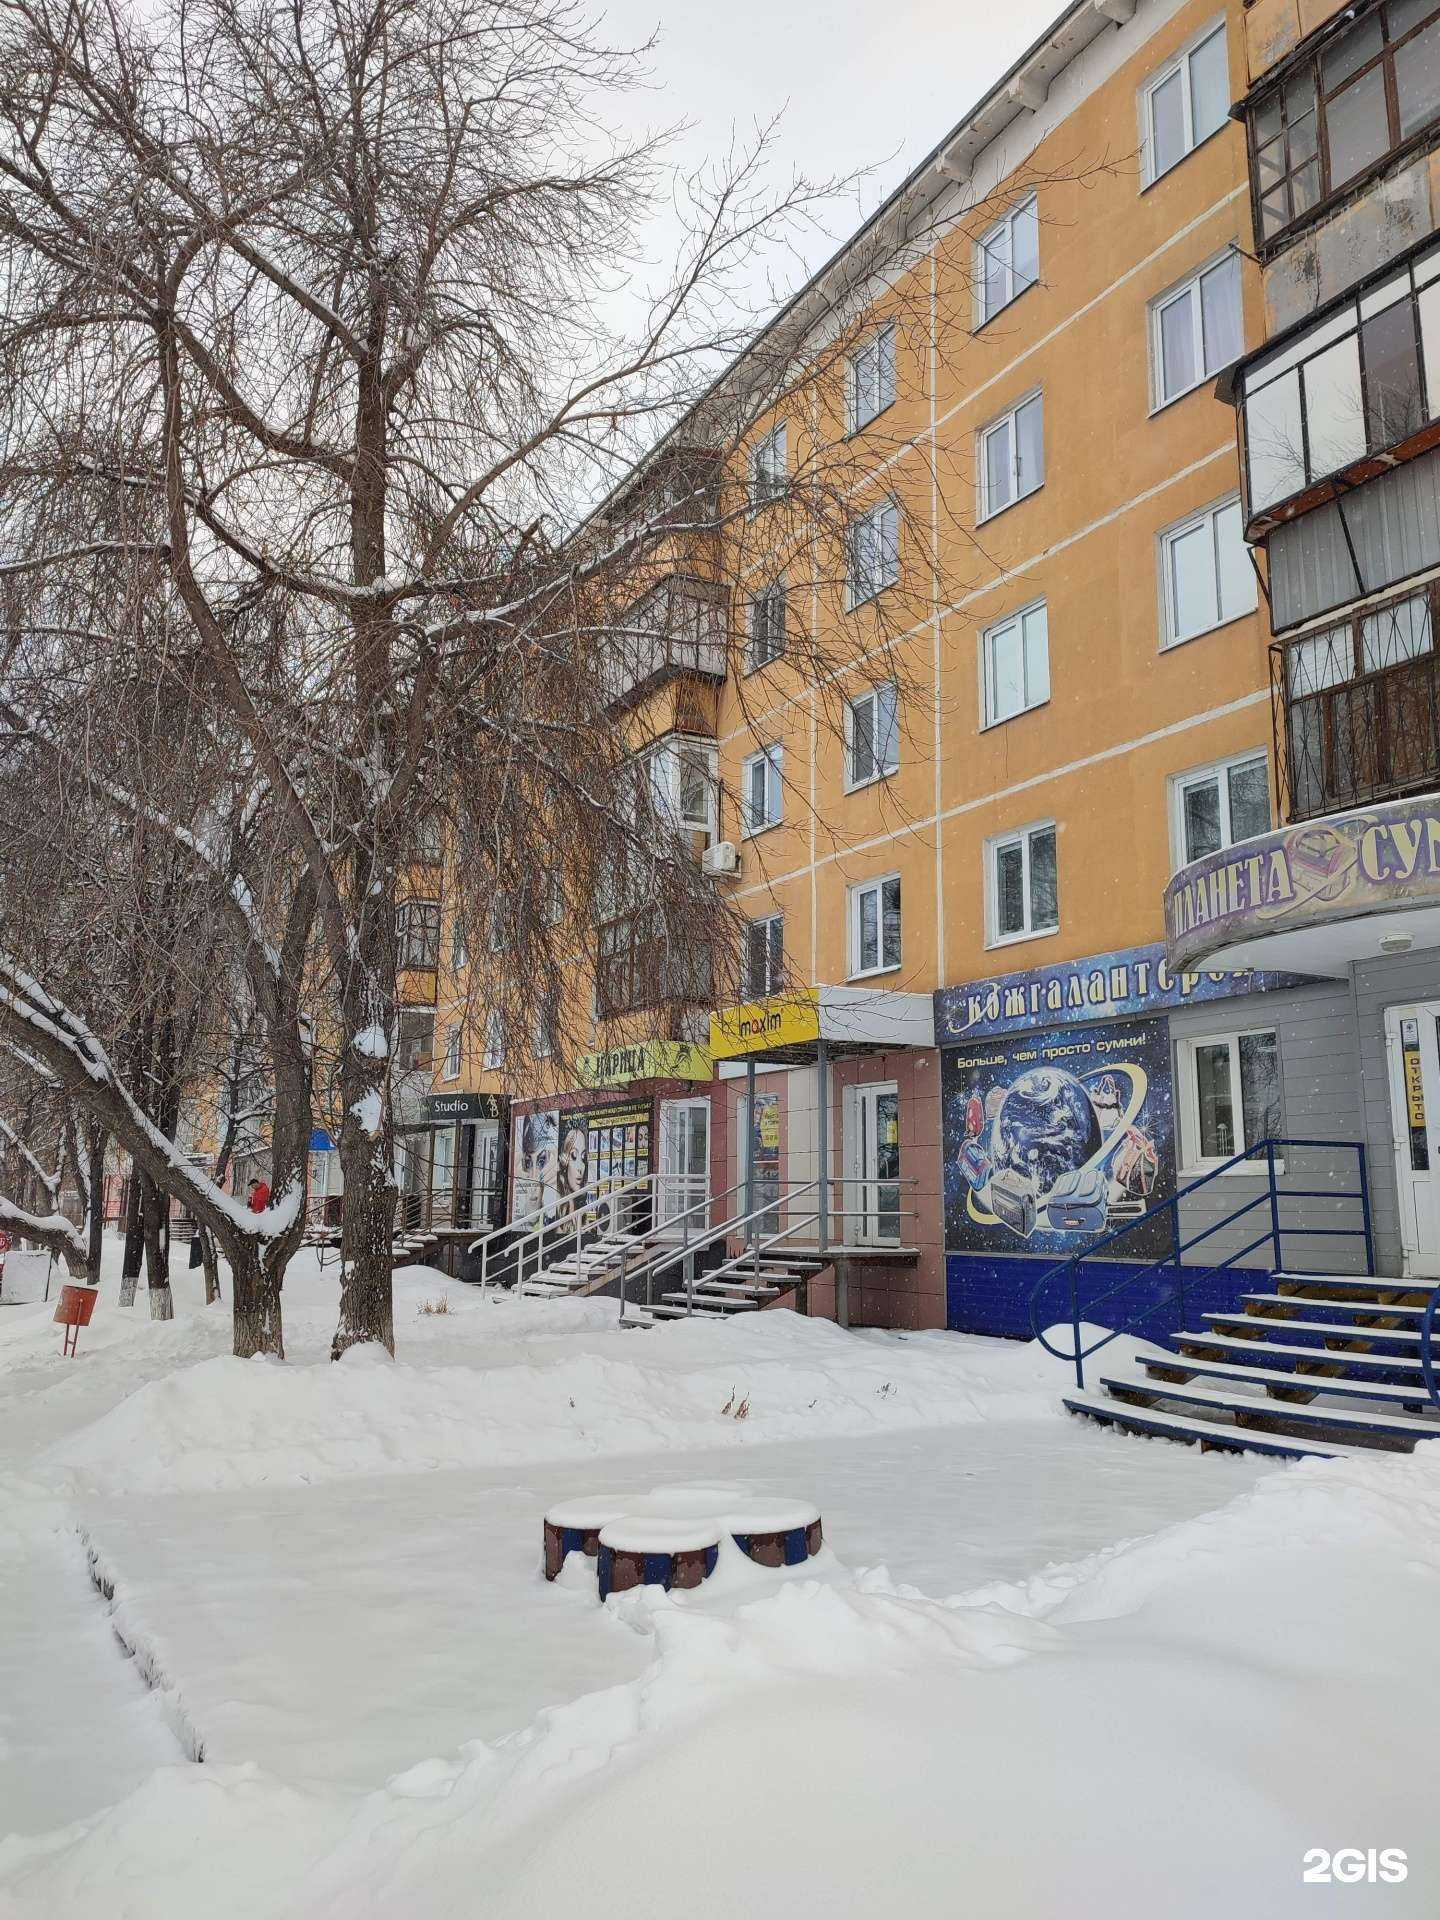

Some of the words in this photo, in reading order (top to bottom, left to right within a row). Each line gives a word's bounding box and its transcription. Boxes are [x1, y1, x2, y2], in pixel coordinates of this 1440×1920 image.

[1173, 848, 1295, 939] ПЛАНЕТА
[740, 1010, 782, 1037] maxim
[957, 1053, 1008, 1069] Больше,
[1012, 1050, 1037, 1062] чем
[1041, 1042, 1091, 1059] просто
[1096, 1034, 1147, 1052] сумки!
[434, 1099, 469, 1112] Studio
[1410, 1057, 1425, 1120] ОТКРЫТО
